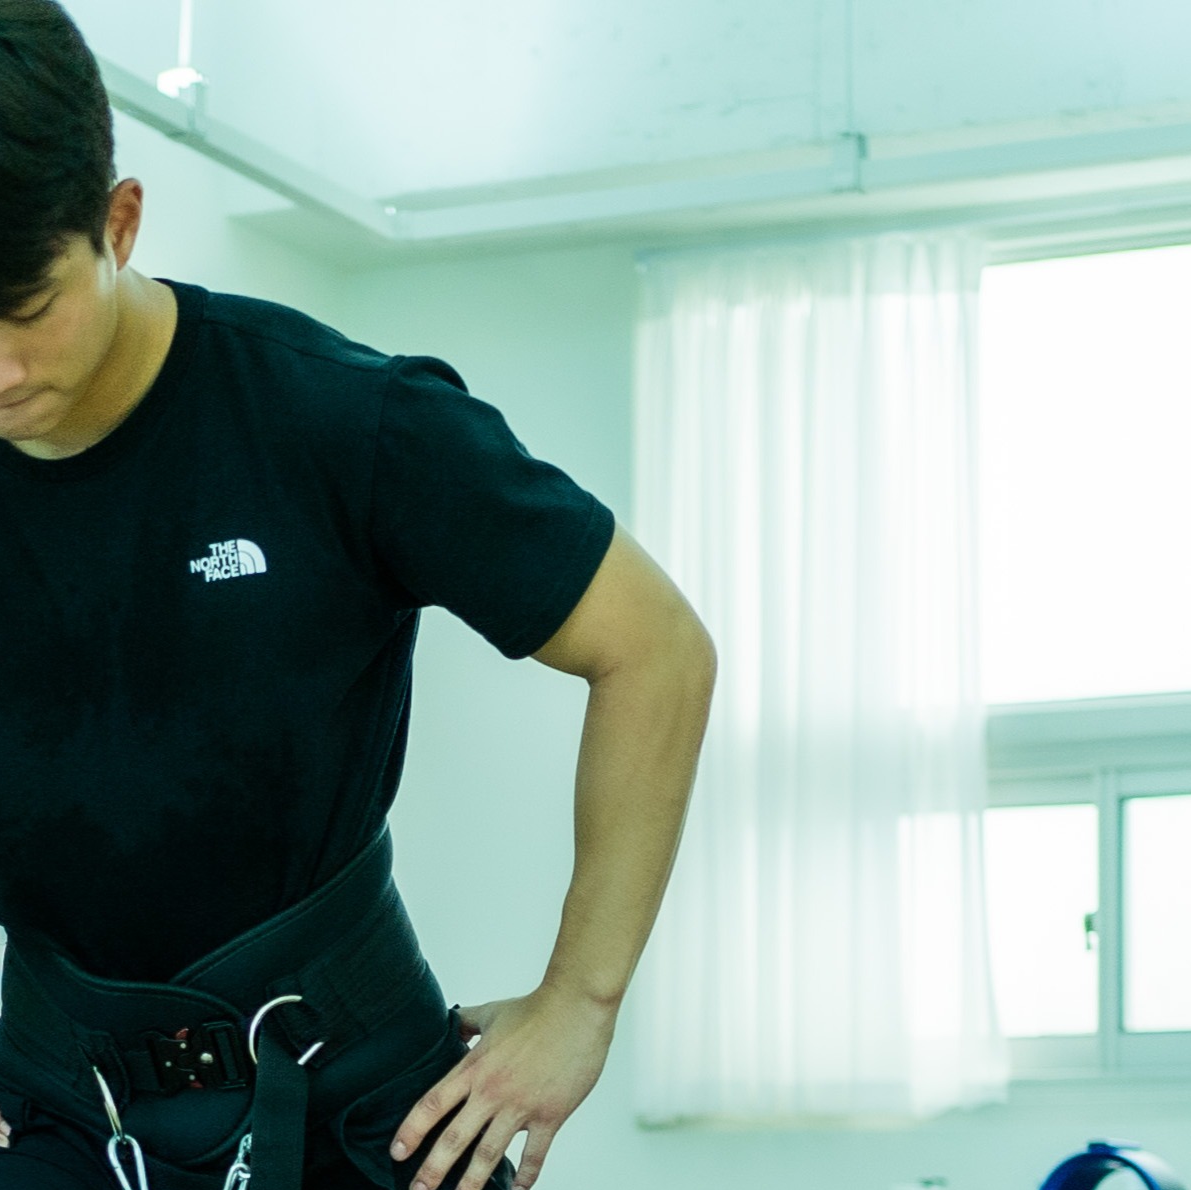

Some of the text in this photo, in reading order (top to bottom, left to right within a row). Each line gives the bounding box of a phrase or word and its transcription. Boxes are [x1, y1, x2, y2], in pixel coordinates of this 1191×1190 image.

[208, 540, 236, 556] THE
[189, 552, 239, 574] NORTH
[204, 564, 240, 583] FACE
